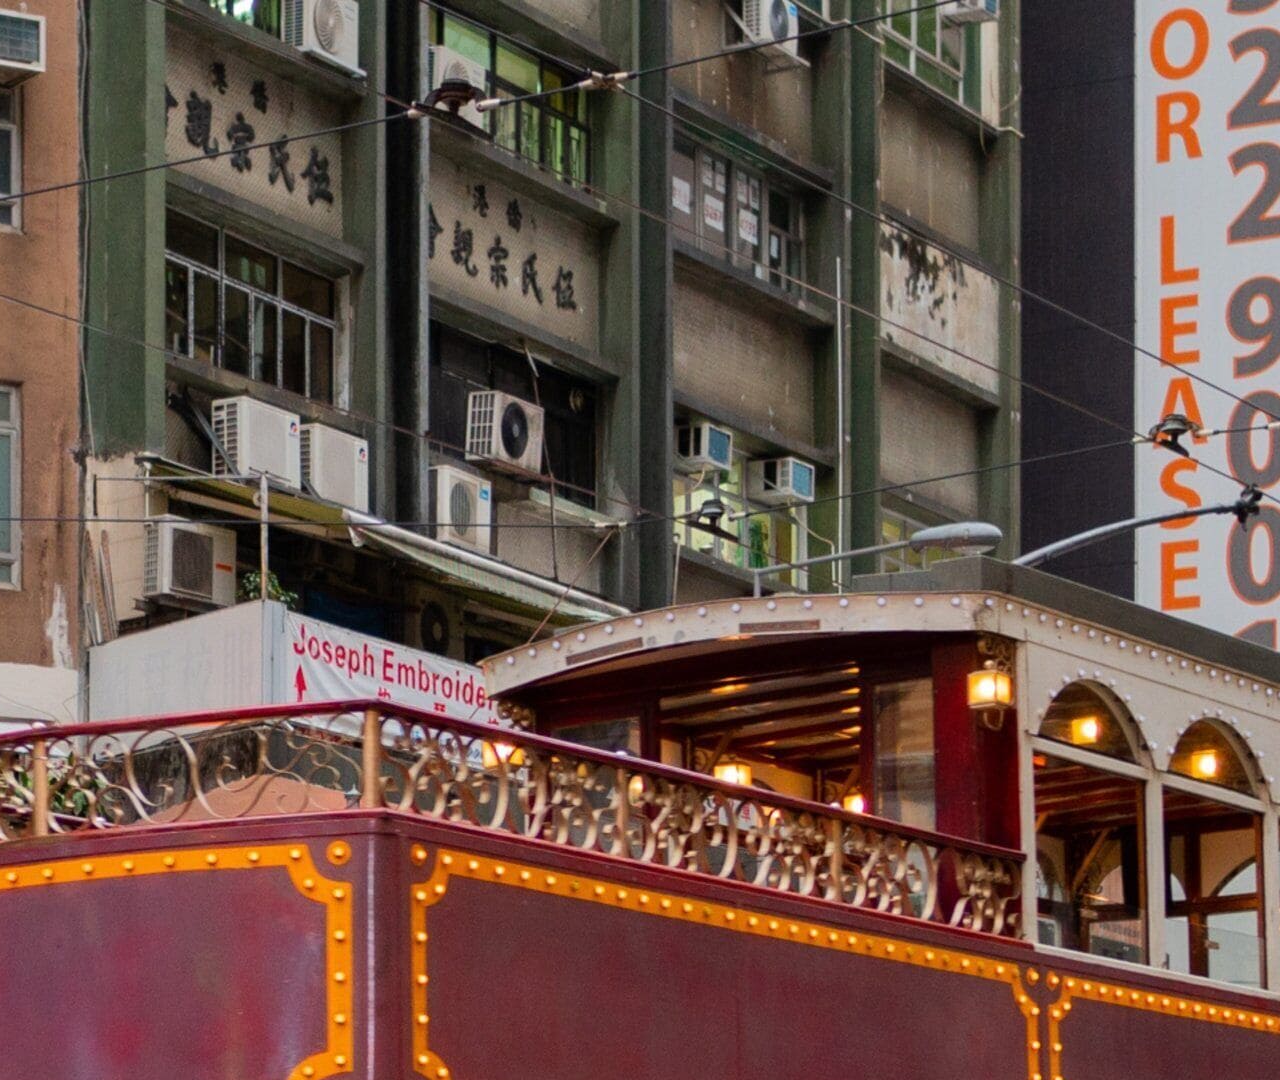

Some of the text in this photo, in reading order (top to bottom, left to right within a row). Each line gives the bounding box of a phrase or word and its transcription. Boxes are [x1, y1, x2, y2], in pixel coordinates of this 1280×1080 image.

[165, 86, 335, 207] 伍氏宗親
[1152, 215, 1208, 611] LEASE
[293, 623, 376, 679] Joseph
